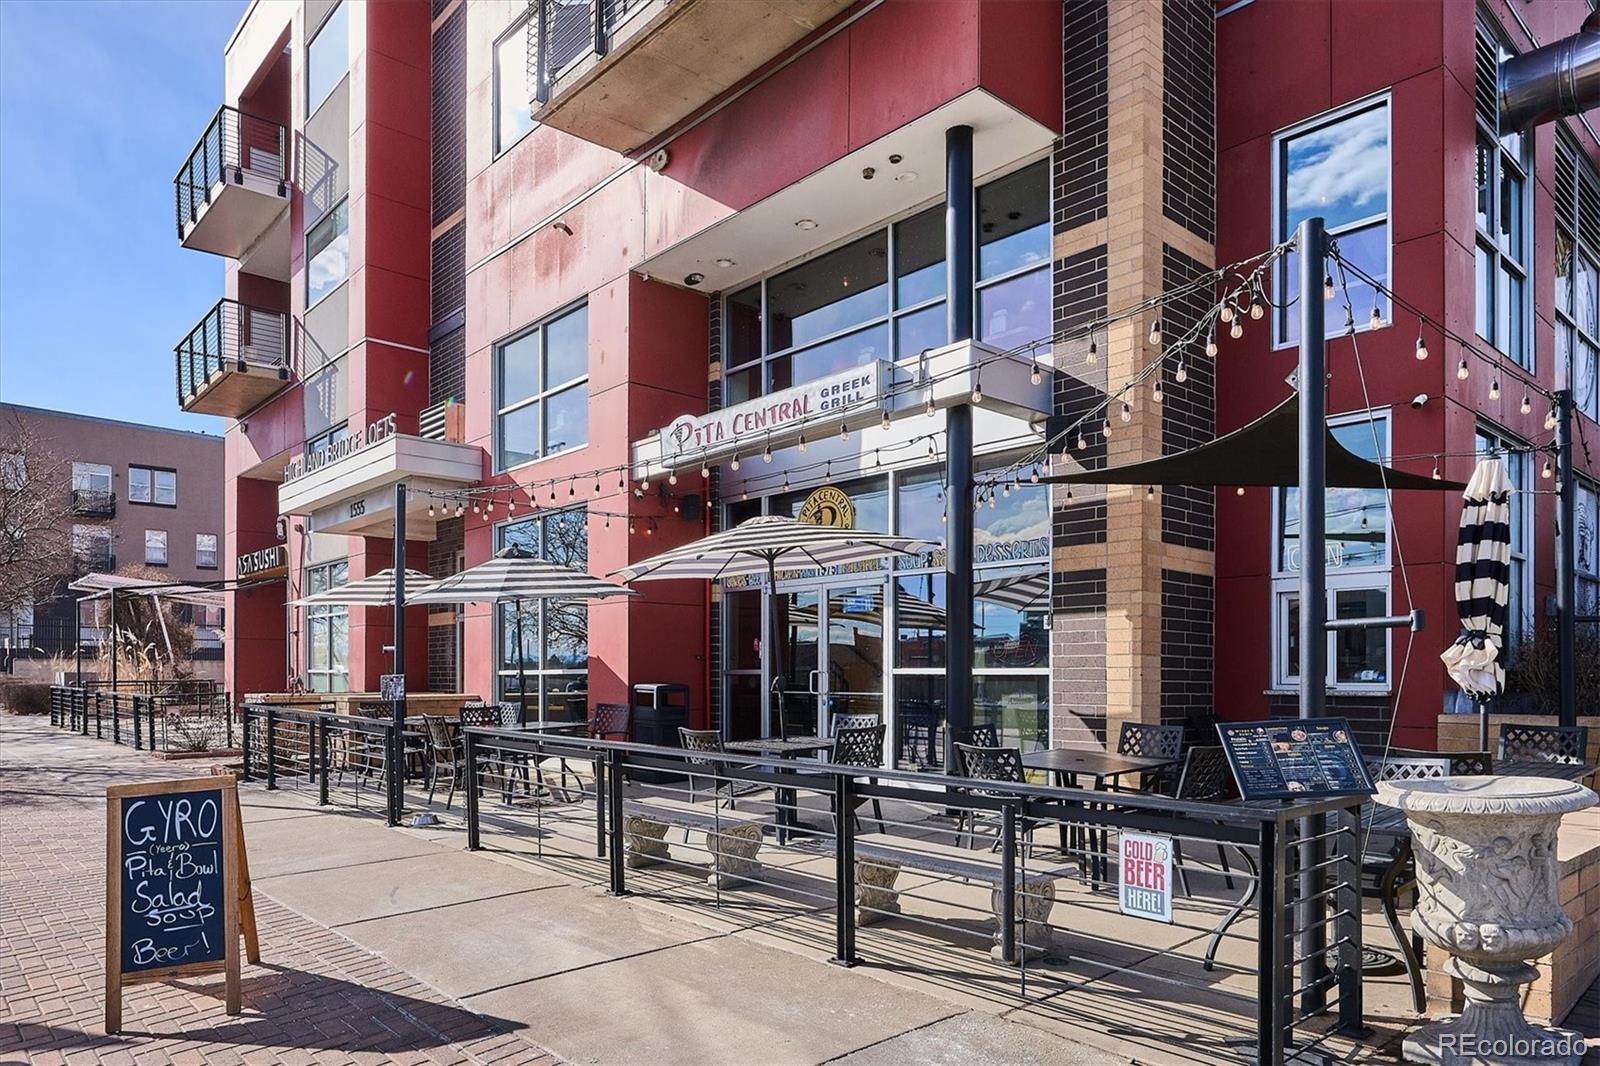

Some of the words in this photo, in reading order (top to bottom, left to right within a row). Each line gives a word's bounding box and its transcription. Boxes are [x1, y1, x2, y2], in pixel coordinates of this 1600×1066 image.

[820, 375, 871, 398] GREEK
[820, 391, 864, 410] GRILL
[732, 394, 813, 435] CENTRAL
[283, 449, 325, 483] HIGHLAND
[328, 430, 362, 463] BRIDGE
[366, 412, 397, 445] LOFTS
[350, 499, 365, 518] 1555
[802, 496, 819, 518] PITA
[818, 490, 850, 518] CENTRAL
[253, 546, 279, 571] SUSHI
[125, 799, 218, 846] GYRO
[1124, 839, 1153, 861] COLD
[125, 856, 168, 880] Pita
[175, 849, 218, 879] Bowl
[1124, 858, 1165, 891] BEER
[131, 880, 211, 913] Salad
[1127, 888, 1162, 913] HERE!
